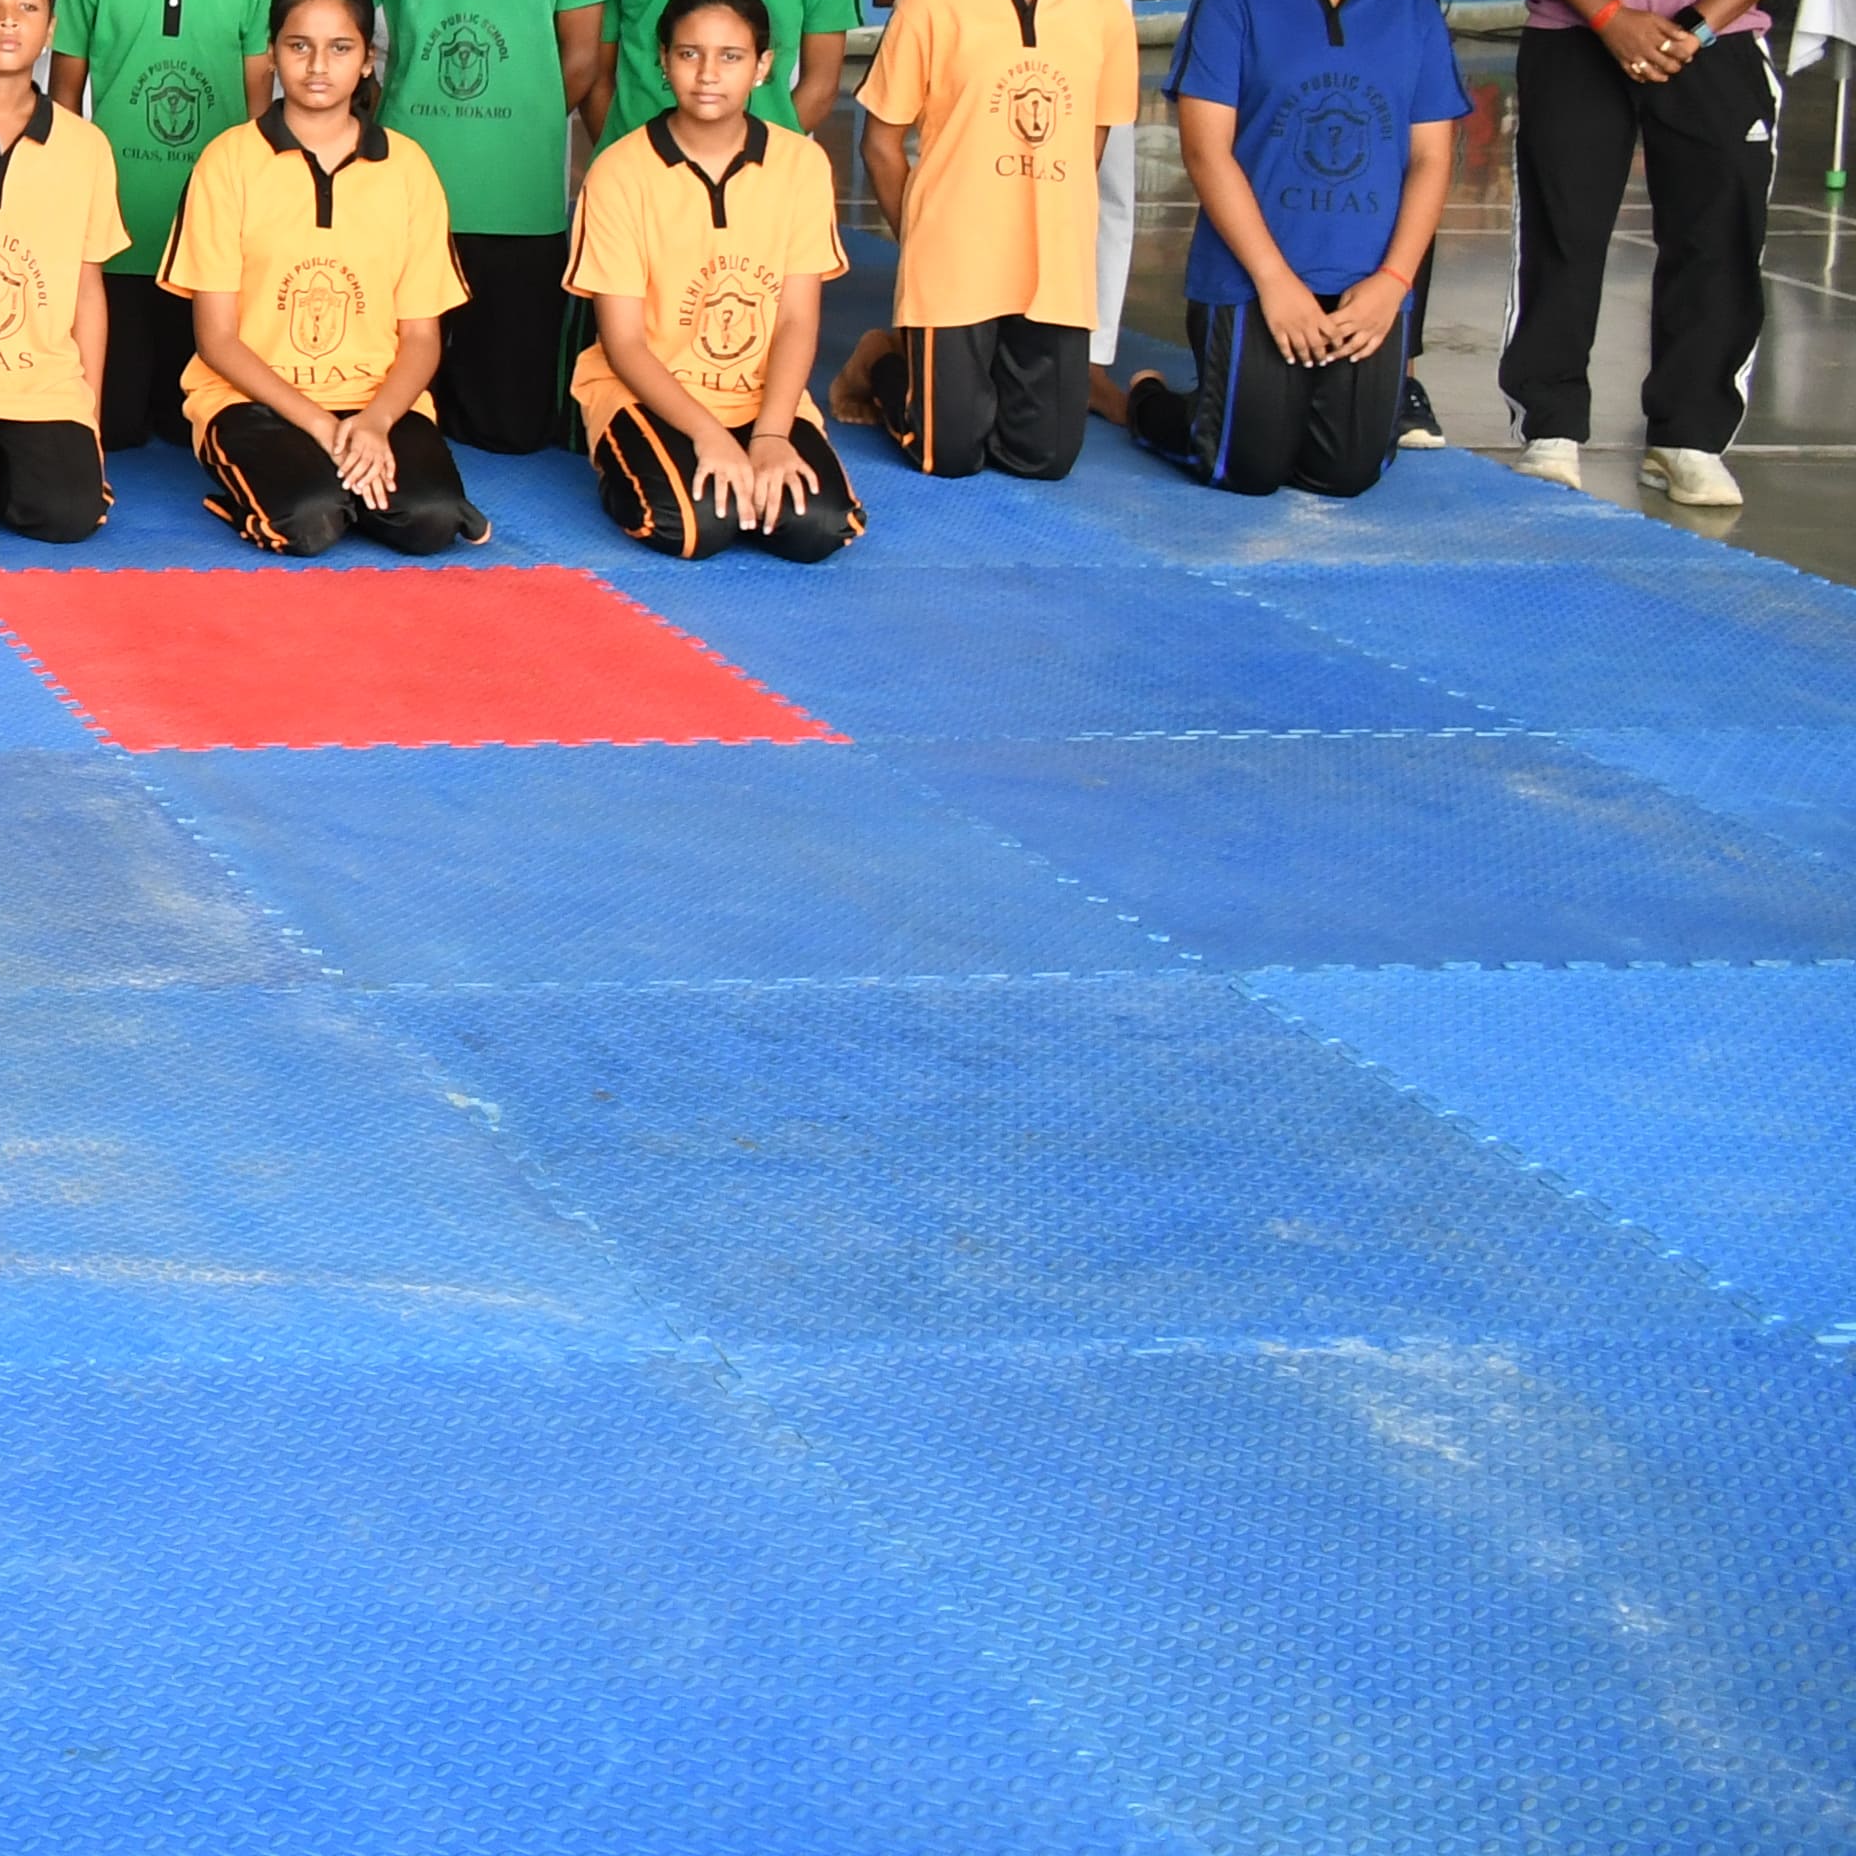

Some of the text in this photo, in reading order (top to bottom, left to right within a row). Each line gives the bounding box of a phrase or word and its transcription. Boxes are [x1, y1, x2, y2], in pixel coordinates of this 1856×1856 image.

[441, 13, 480, 30] PUBLIC
[481, 19, 509, 62] SCHOOL
[148, 60, 187, 76] PUBLIC
[190, 67, 215, 109] SCHOOL
[1008, 61, 1048, 78] PUBLIC
[1300, 72, 1360, 93] PUBLIC
[456, 106, 512, 119] BOKARO
[168, 151, 195, 163] BOK
[1279, 187, 1379, 214] CHAS
[21, 249, 48, 308] SCHOOL
[277, 273, 294, 311] DELHI
[340, 266, 366, 315] SCHOOL
[679, 255, 782, 326] DELHI PUBLIC SCHO
